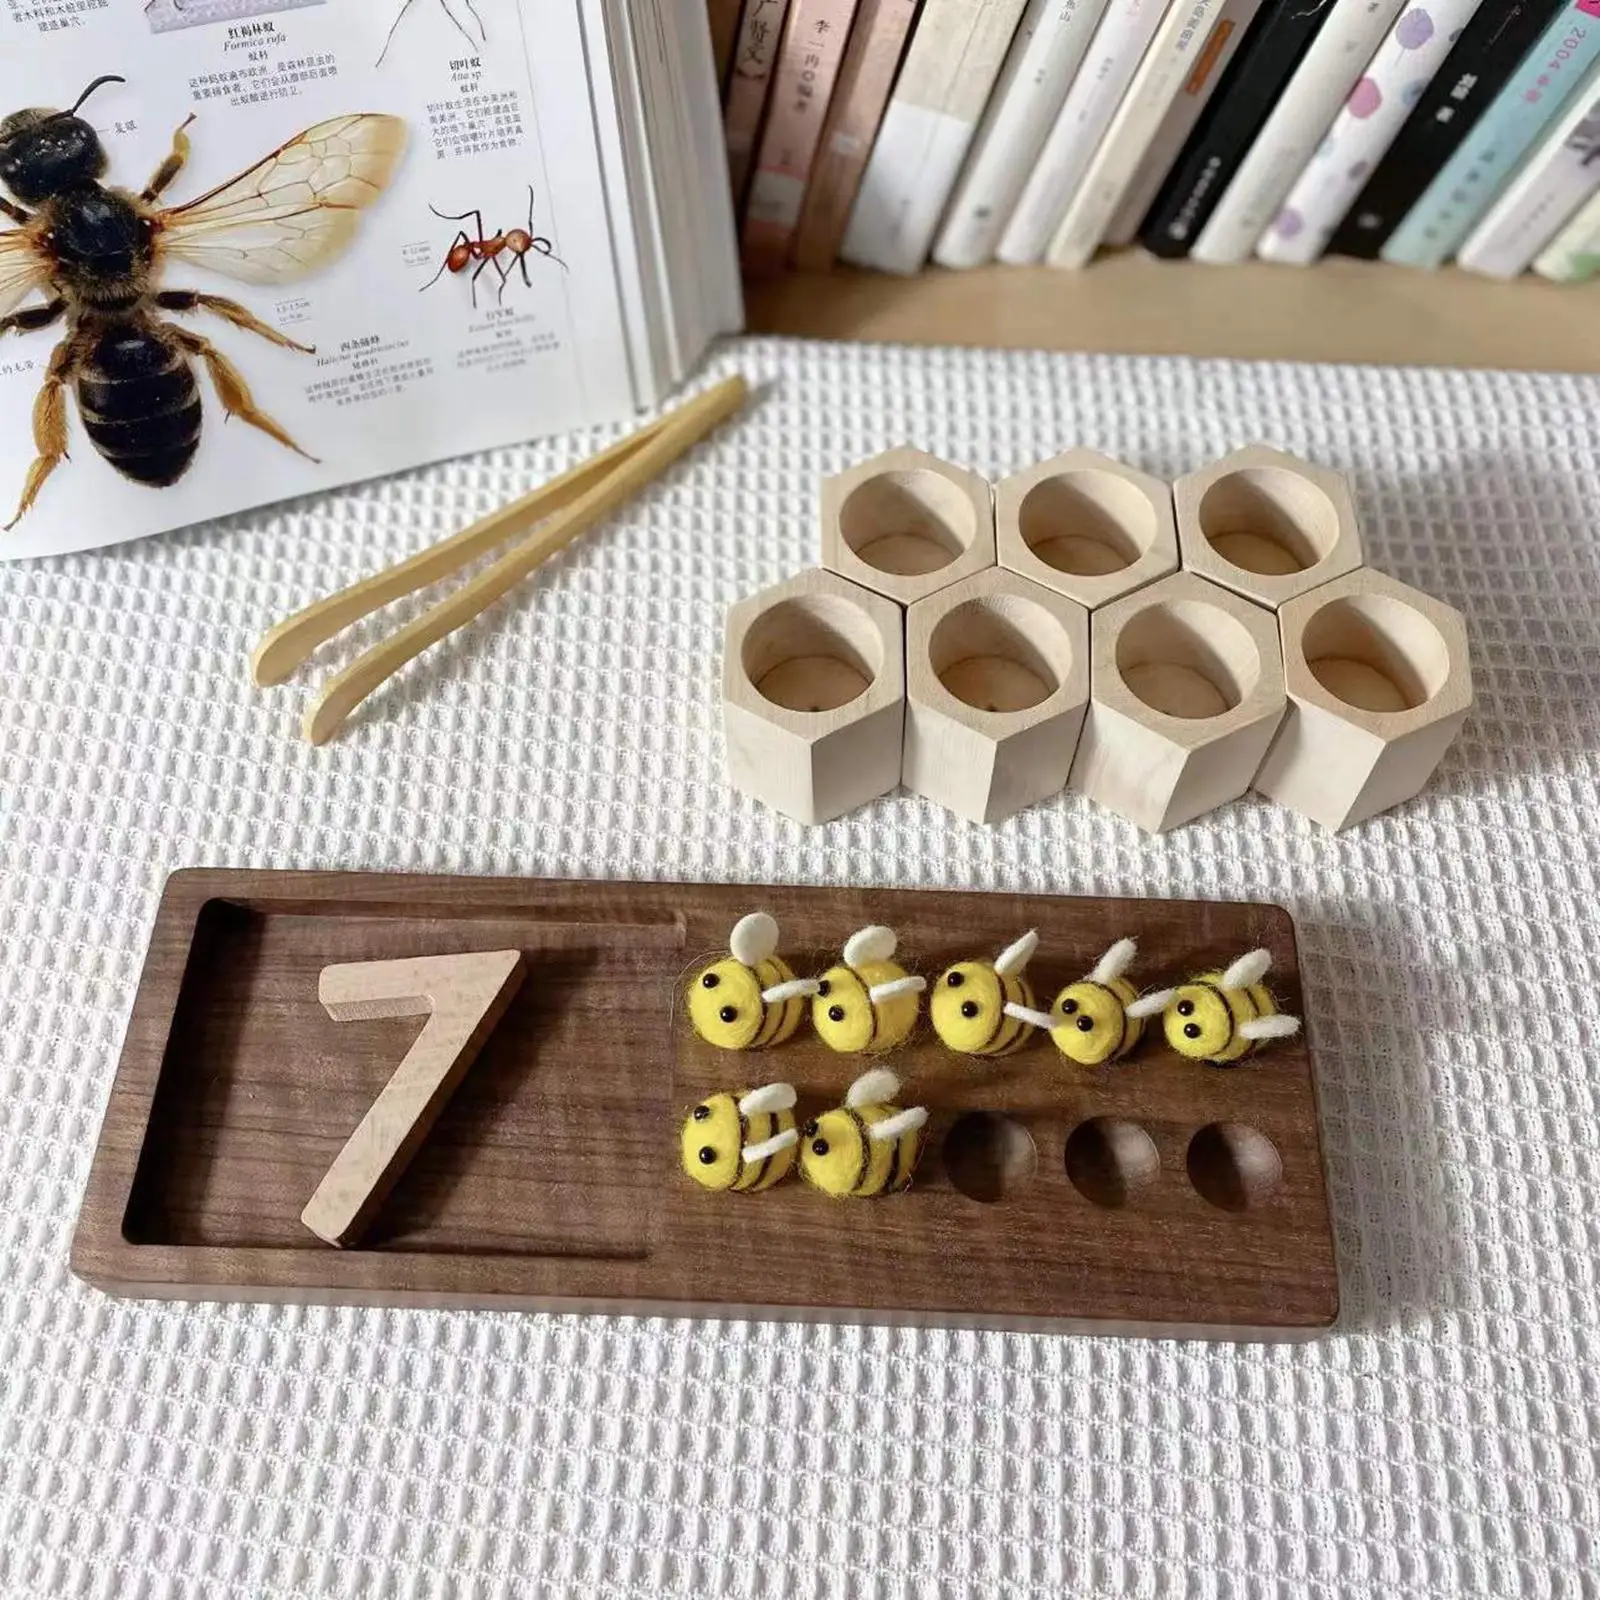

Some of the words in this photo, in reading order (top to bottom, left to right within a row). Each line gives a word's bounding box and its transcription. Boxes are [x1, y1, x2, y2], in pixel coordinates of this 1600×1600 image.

[228, 21, 275, 39] 红褐林蚁
[223, 36, 264, 51] Formica
[266, 33, 287, 47] rufa
[449, 57, 481, 70] 切叶蚁
[301, 949, 527, 1248] 7
